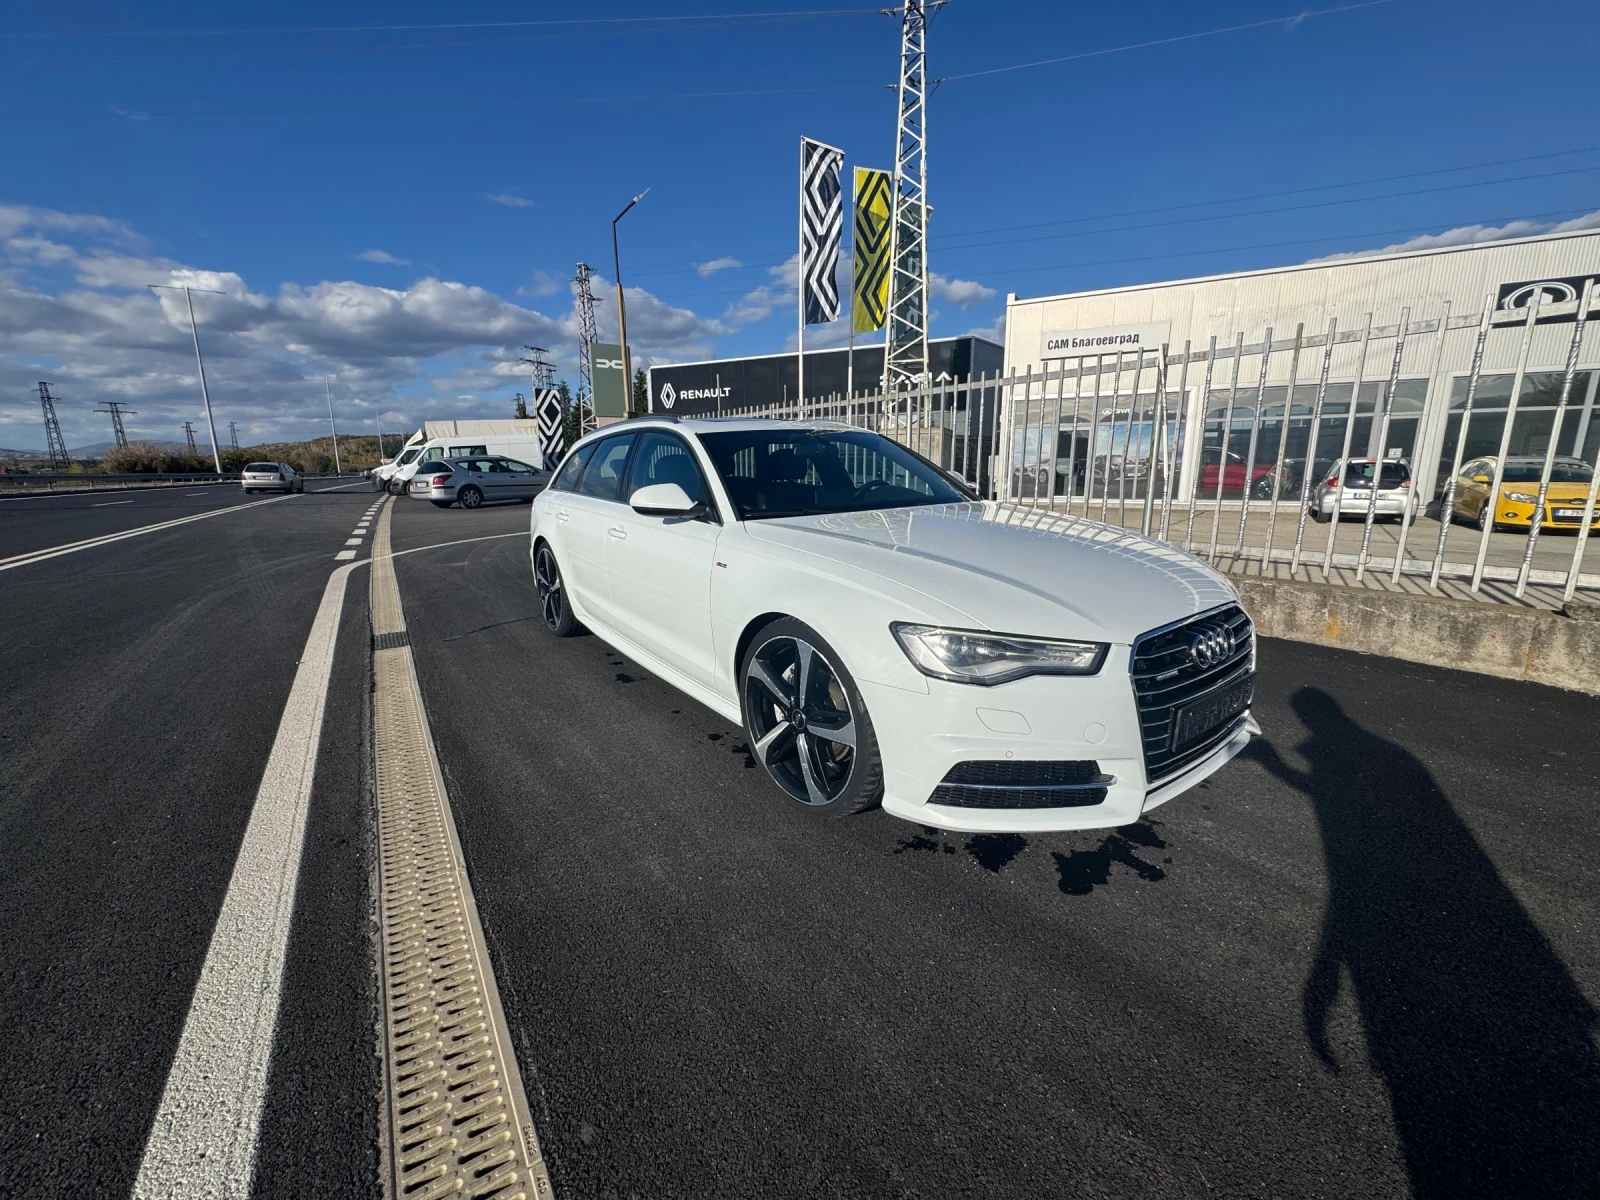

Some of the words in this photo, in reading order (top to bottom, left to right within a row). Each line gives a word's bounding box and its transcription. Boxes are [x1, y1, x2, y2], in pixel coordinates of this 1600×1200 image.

[1047, 338, 1069, 350] САМ
[1071, 333, 1140, 348] Благоевград
[680, 387, 731, 400] RENAULT
